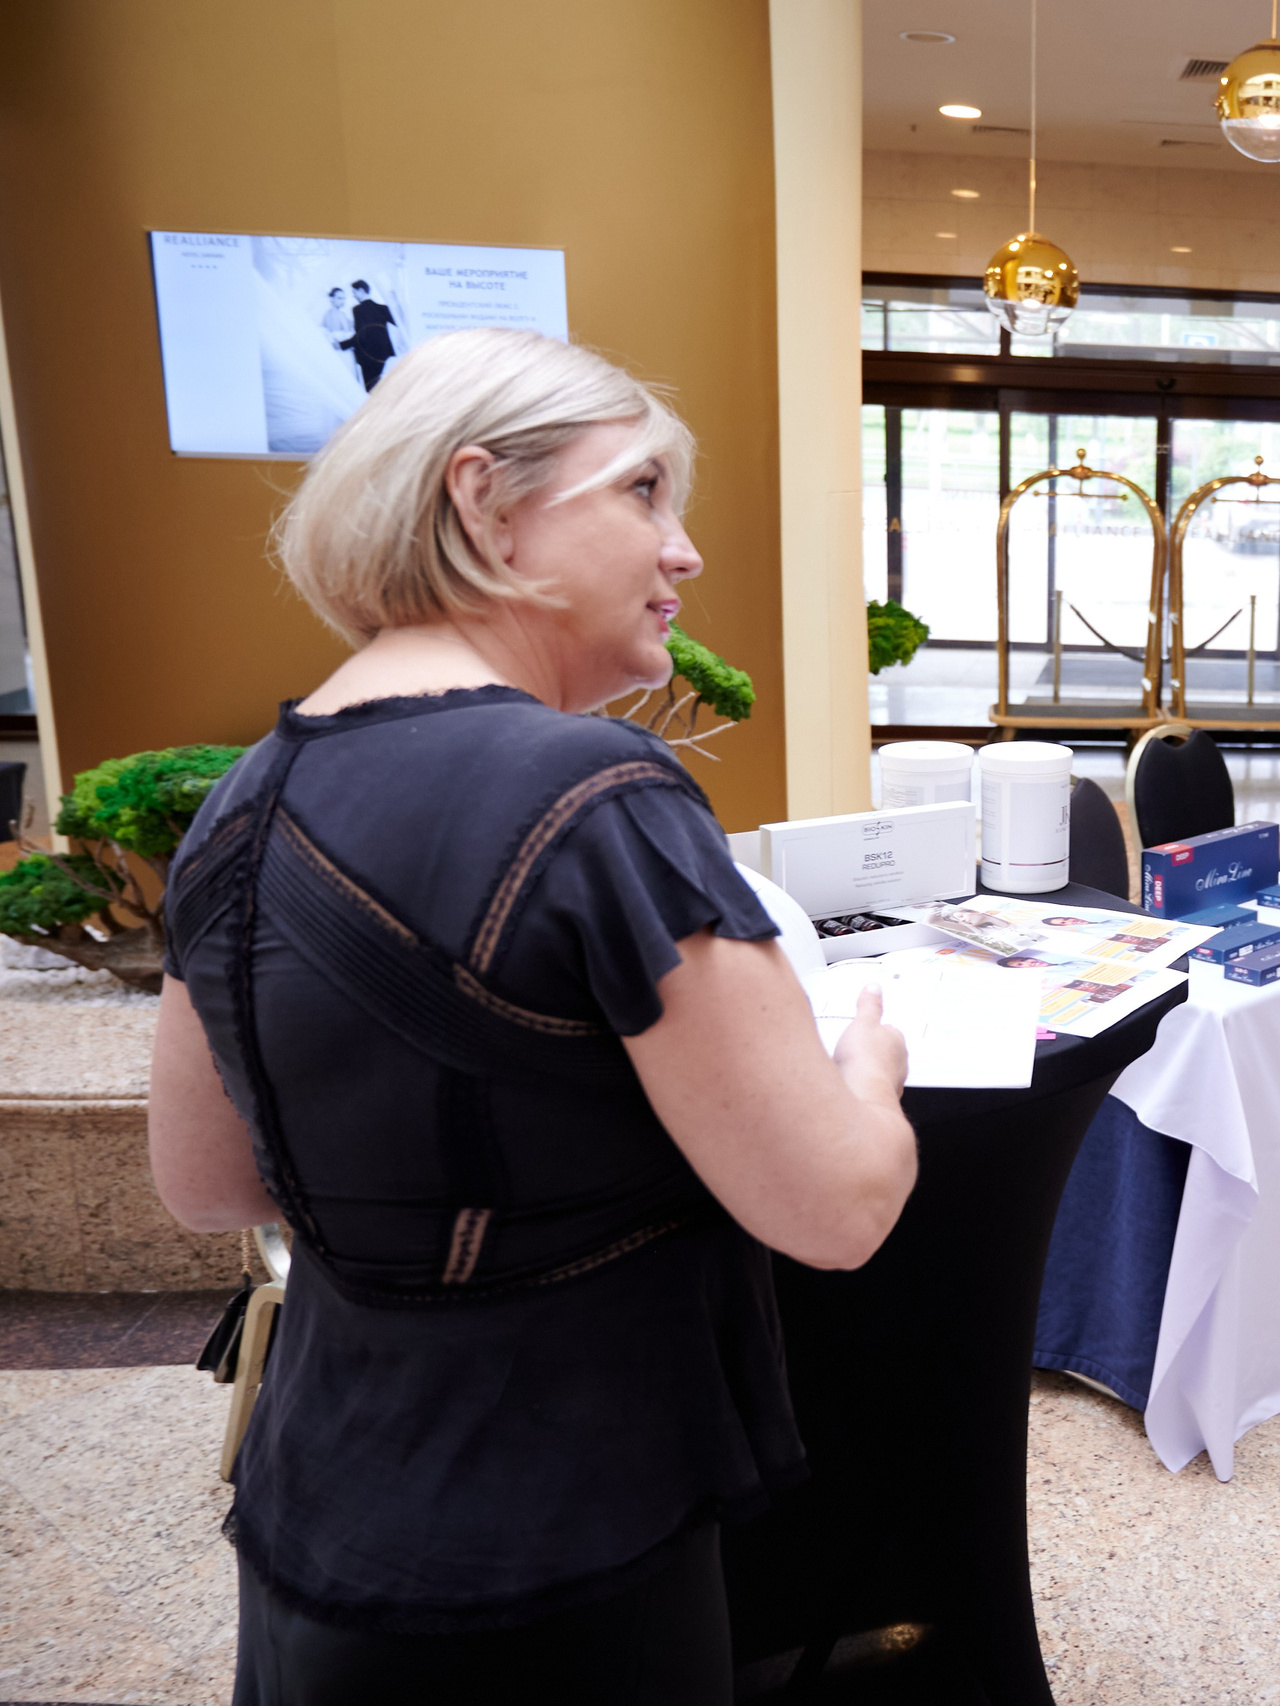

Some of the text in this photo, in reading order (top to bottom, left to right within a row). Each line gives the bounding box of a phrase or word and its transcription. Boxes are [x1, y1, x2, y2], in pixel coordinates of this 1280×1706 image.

[163, 234, 241, 248] REALLIANCE
[424, 266, 528, 280] ВАШЕ МЕРОПРИЯТИЕ
[449, 280, 506, 291] НА ВЫСОТЕ
[864, 850, 893, 862] BSK12
[862, 859, 896, 870] REDUPRO
[1196, 861, 1253, 891] Mira Line
[1154, 880, 1163, 902] DEEP
